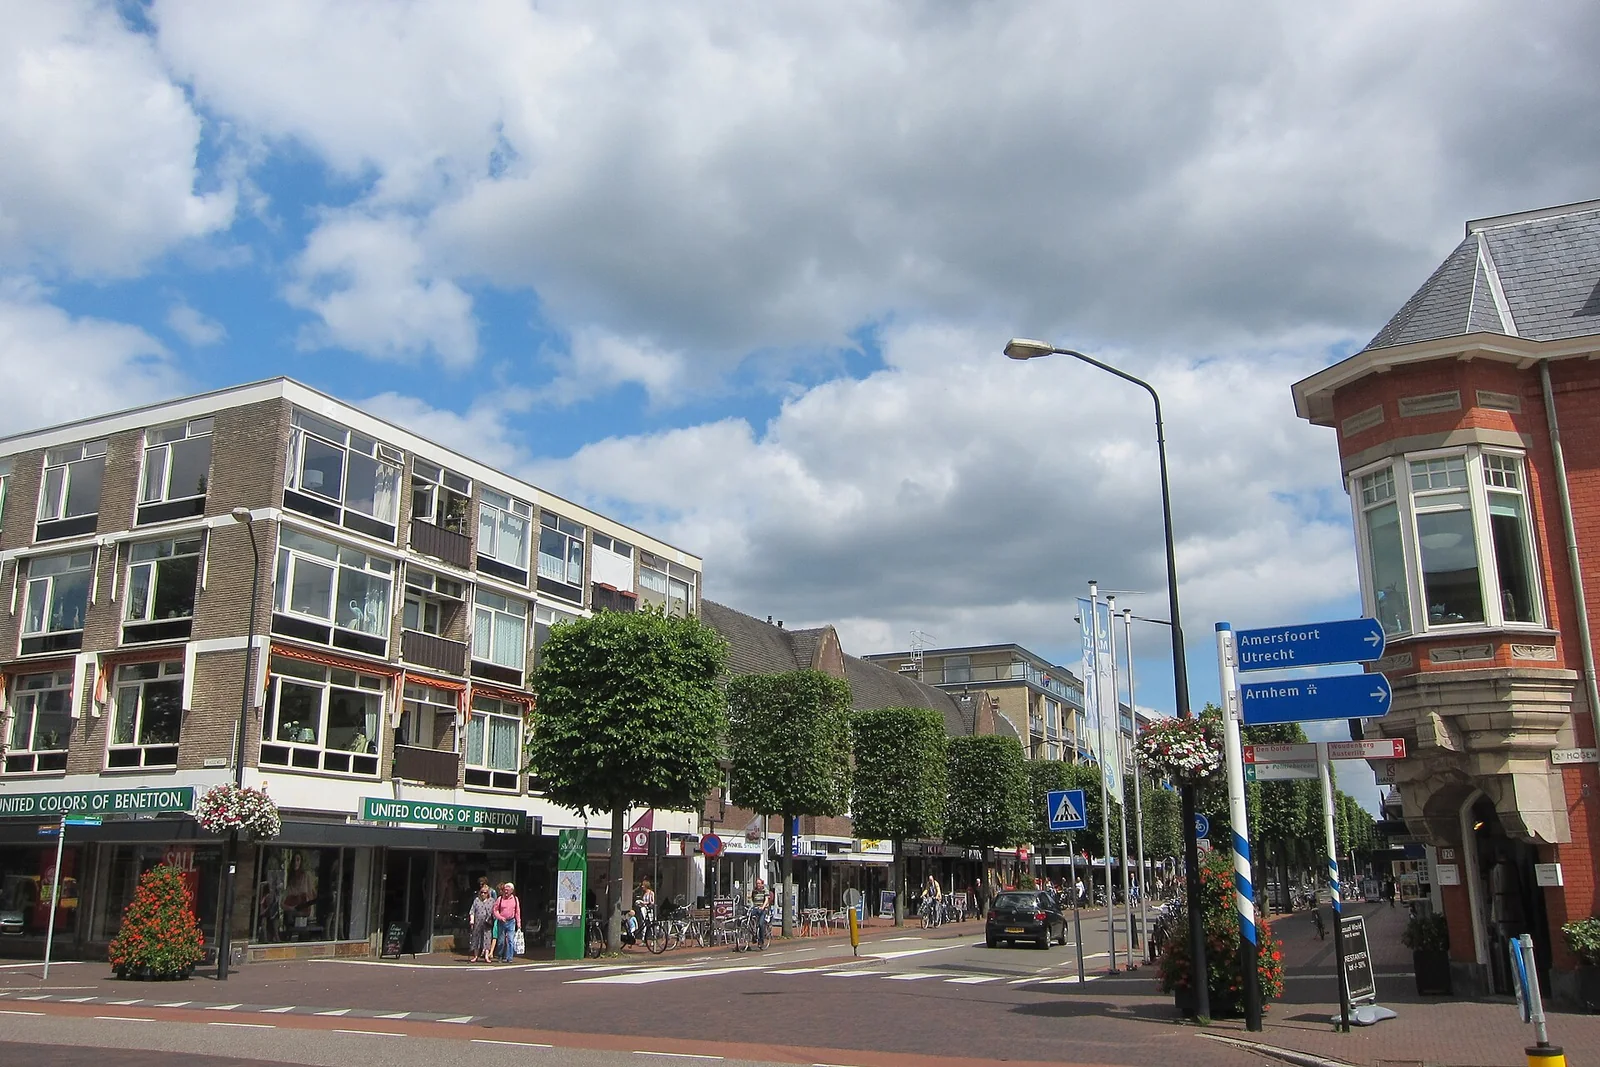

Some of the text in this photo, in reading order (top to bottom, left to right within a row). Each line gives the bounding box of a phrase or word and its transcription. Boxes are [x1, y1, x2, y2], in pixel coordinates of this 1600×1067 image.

[1241, 629, 1320, 646] Amersfoort
[1242, 649, 1295, 663] Utrecht
[1246, 687, 1299, 699] Arnhem
[0, 797, 34, 812] UNITED
[39, 795, 87, 811] COLORS
[92, 794, 109, 809] OF
[371, 802, 409, 818] UNITED
[413, 805, 454, 821] COLORS
[457, 810, 470, 822] OF
